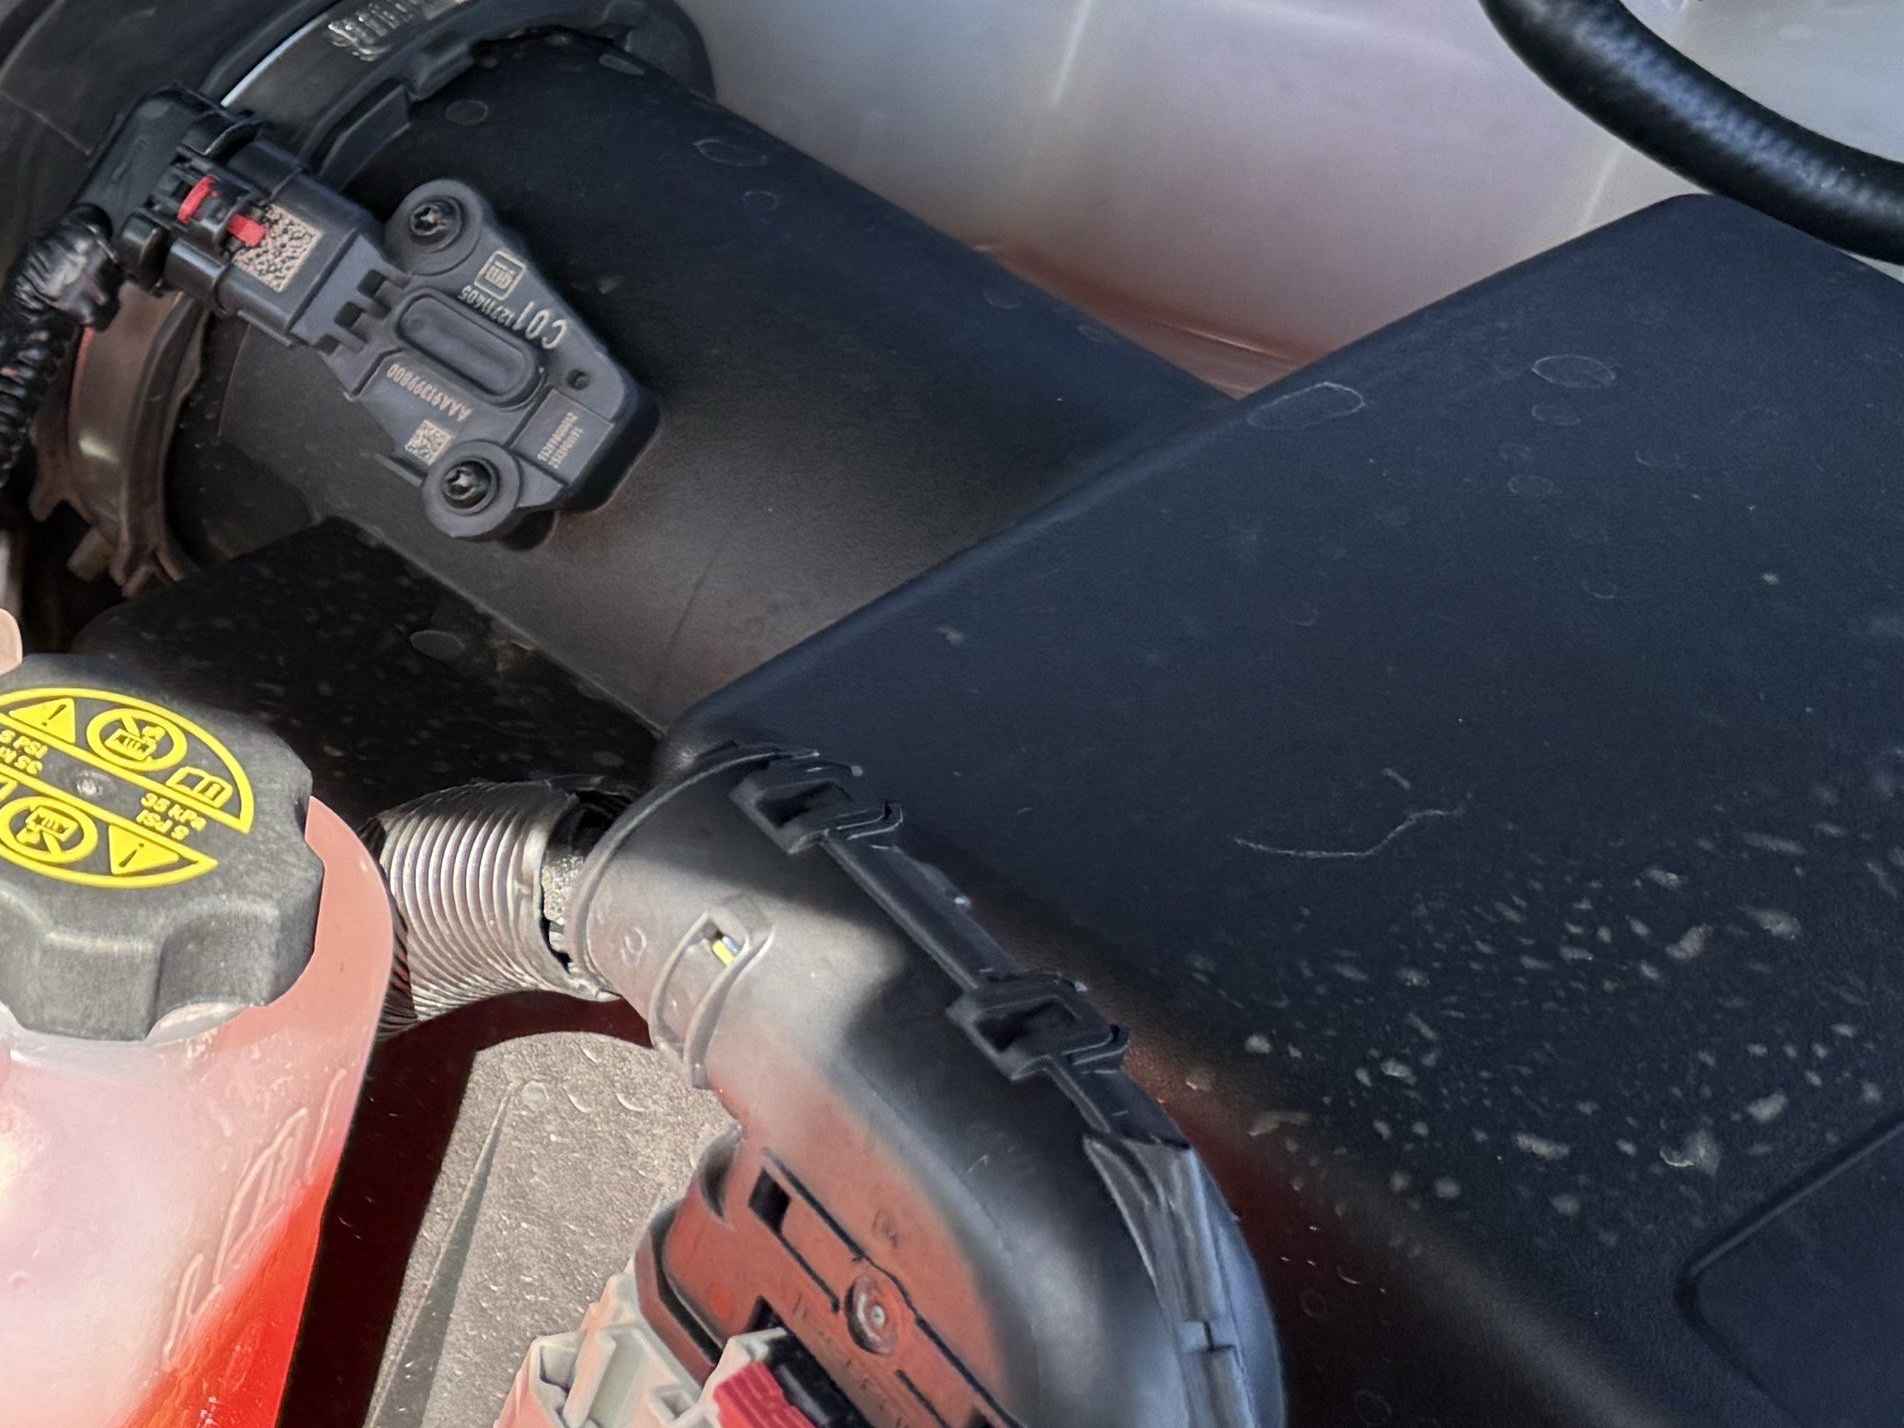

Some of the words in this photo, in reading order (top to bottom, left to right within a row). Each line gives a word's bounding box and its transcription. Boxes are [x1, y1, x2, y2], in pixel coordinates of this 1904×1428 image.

[12, 735, 49, 760] PSI
[140, 792, 171, 813] 35
[135, 809, 173, 834] PSI
